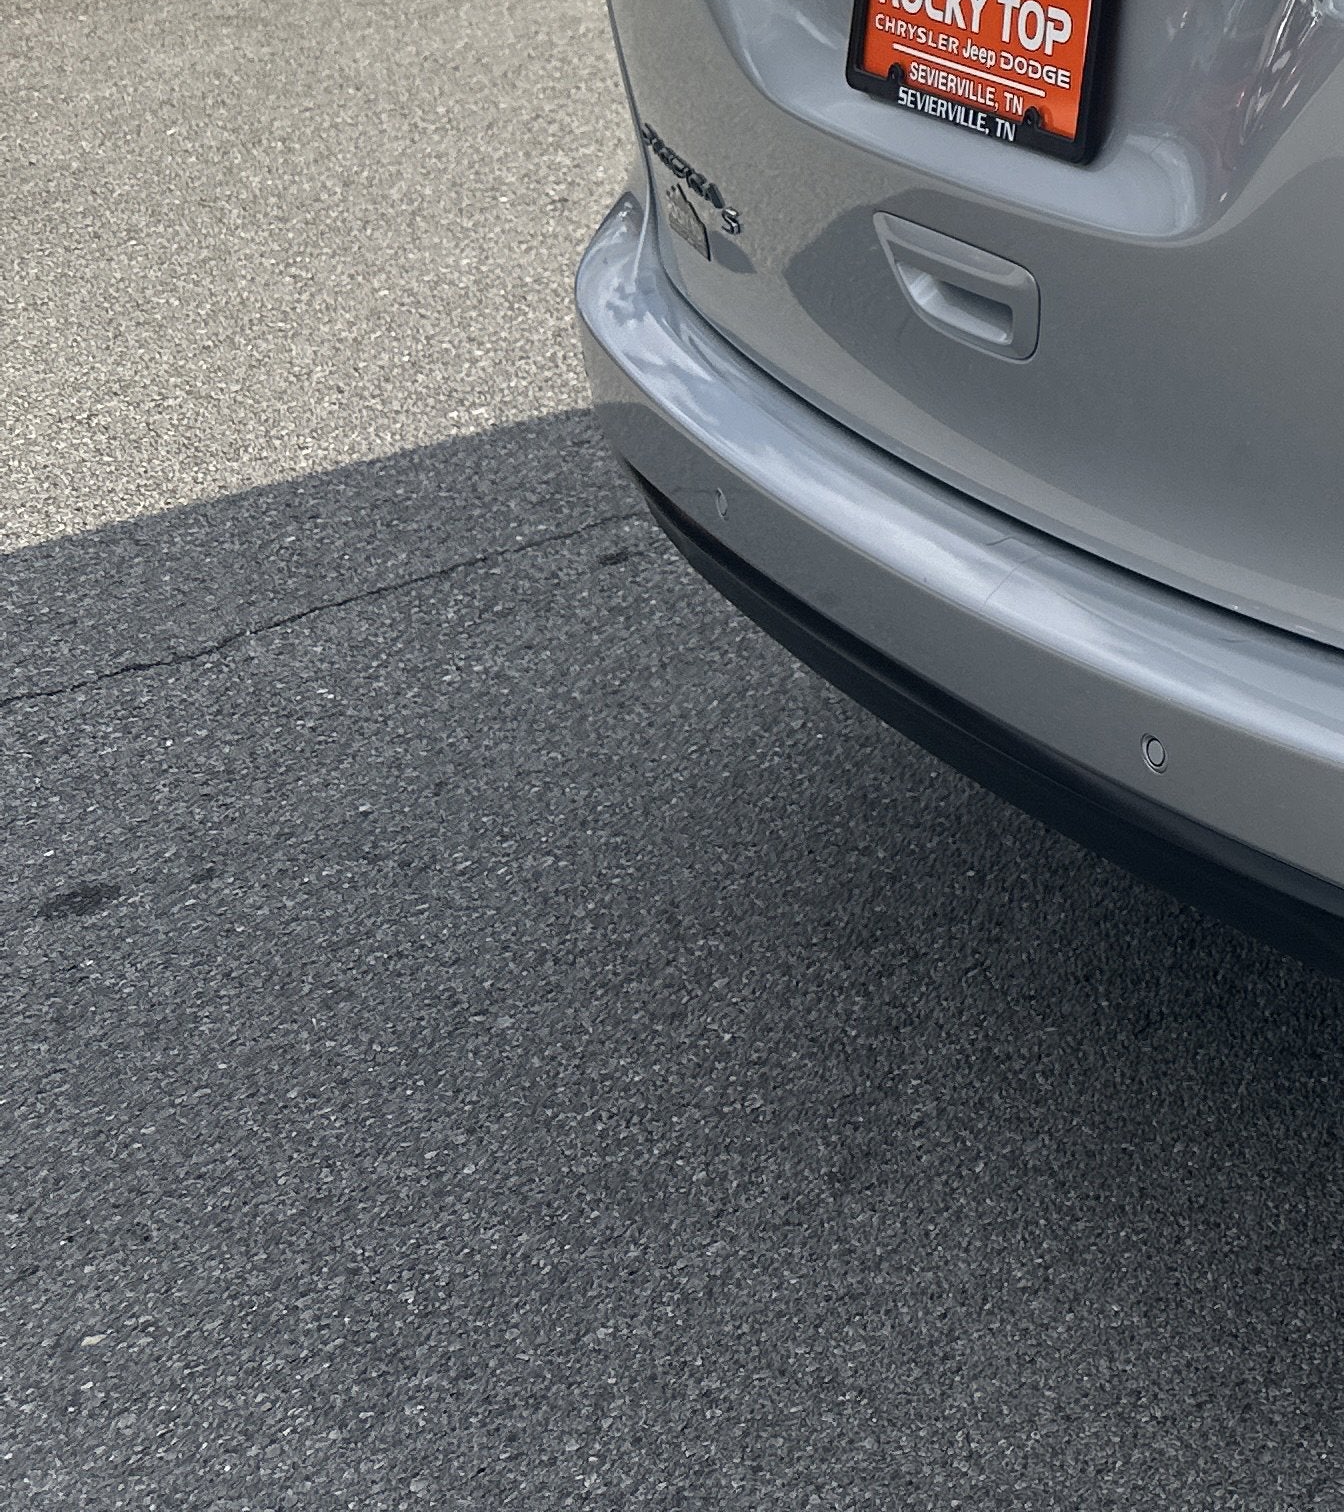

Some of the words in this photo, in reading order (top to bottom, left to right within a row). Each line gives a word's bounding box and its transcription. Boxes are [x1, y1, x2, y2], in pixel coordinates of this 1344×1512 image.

[875, 13, 960, 54] CHRYSLER
[962, 38, 996, 69] Jeep
[1000, 51, 1071, 89] DODGE
[897, 86, 990, 135] SEVIERVILLE,
[995, 117, 1016, 142] TN
[909, 61, 999, 111] SEVIERVILLE,
[1003, 91, 1024, 116] TN
